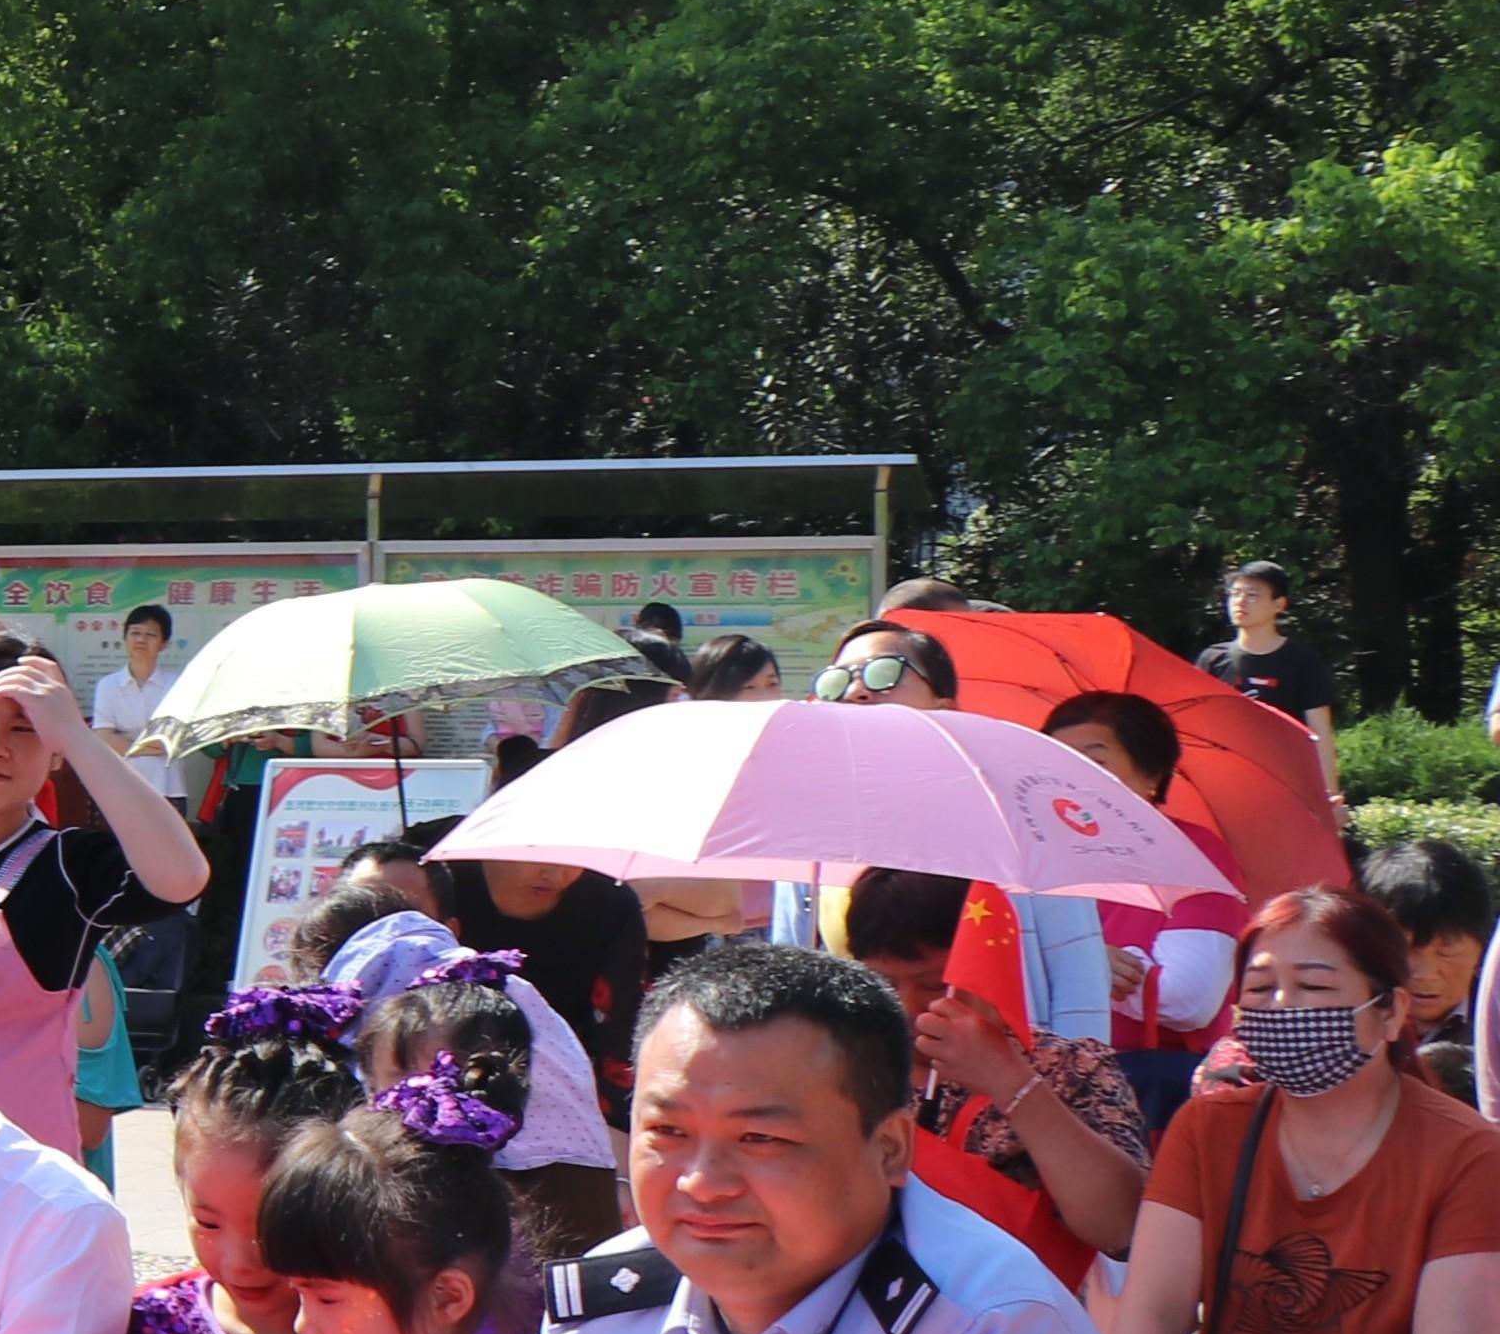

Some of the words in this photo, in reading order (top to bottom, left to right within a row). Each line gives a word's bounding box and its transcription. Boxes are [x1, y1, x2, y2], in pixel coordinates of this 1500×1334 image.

[421, 572, 798, 599] 诈骗防火宣传栏
